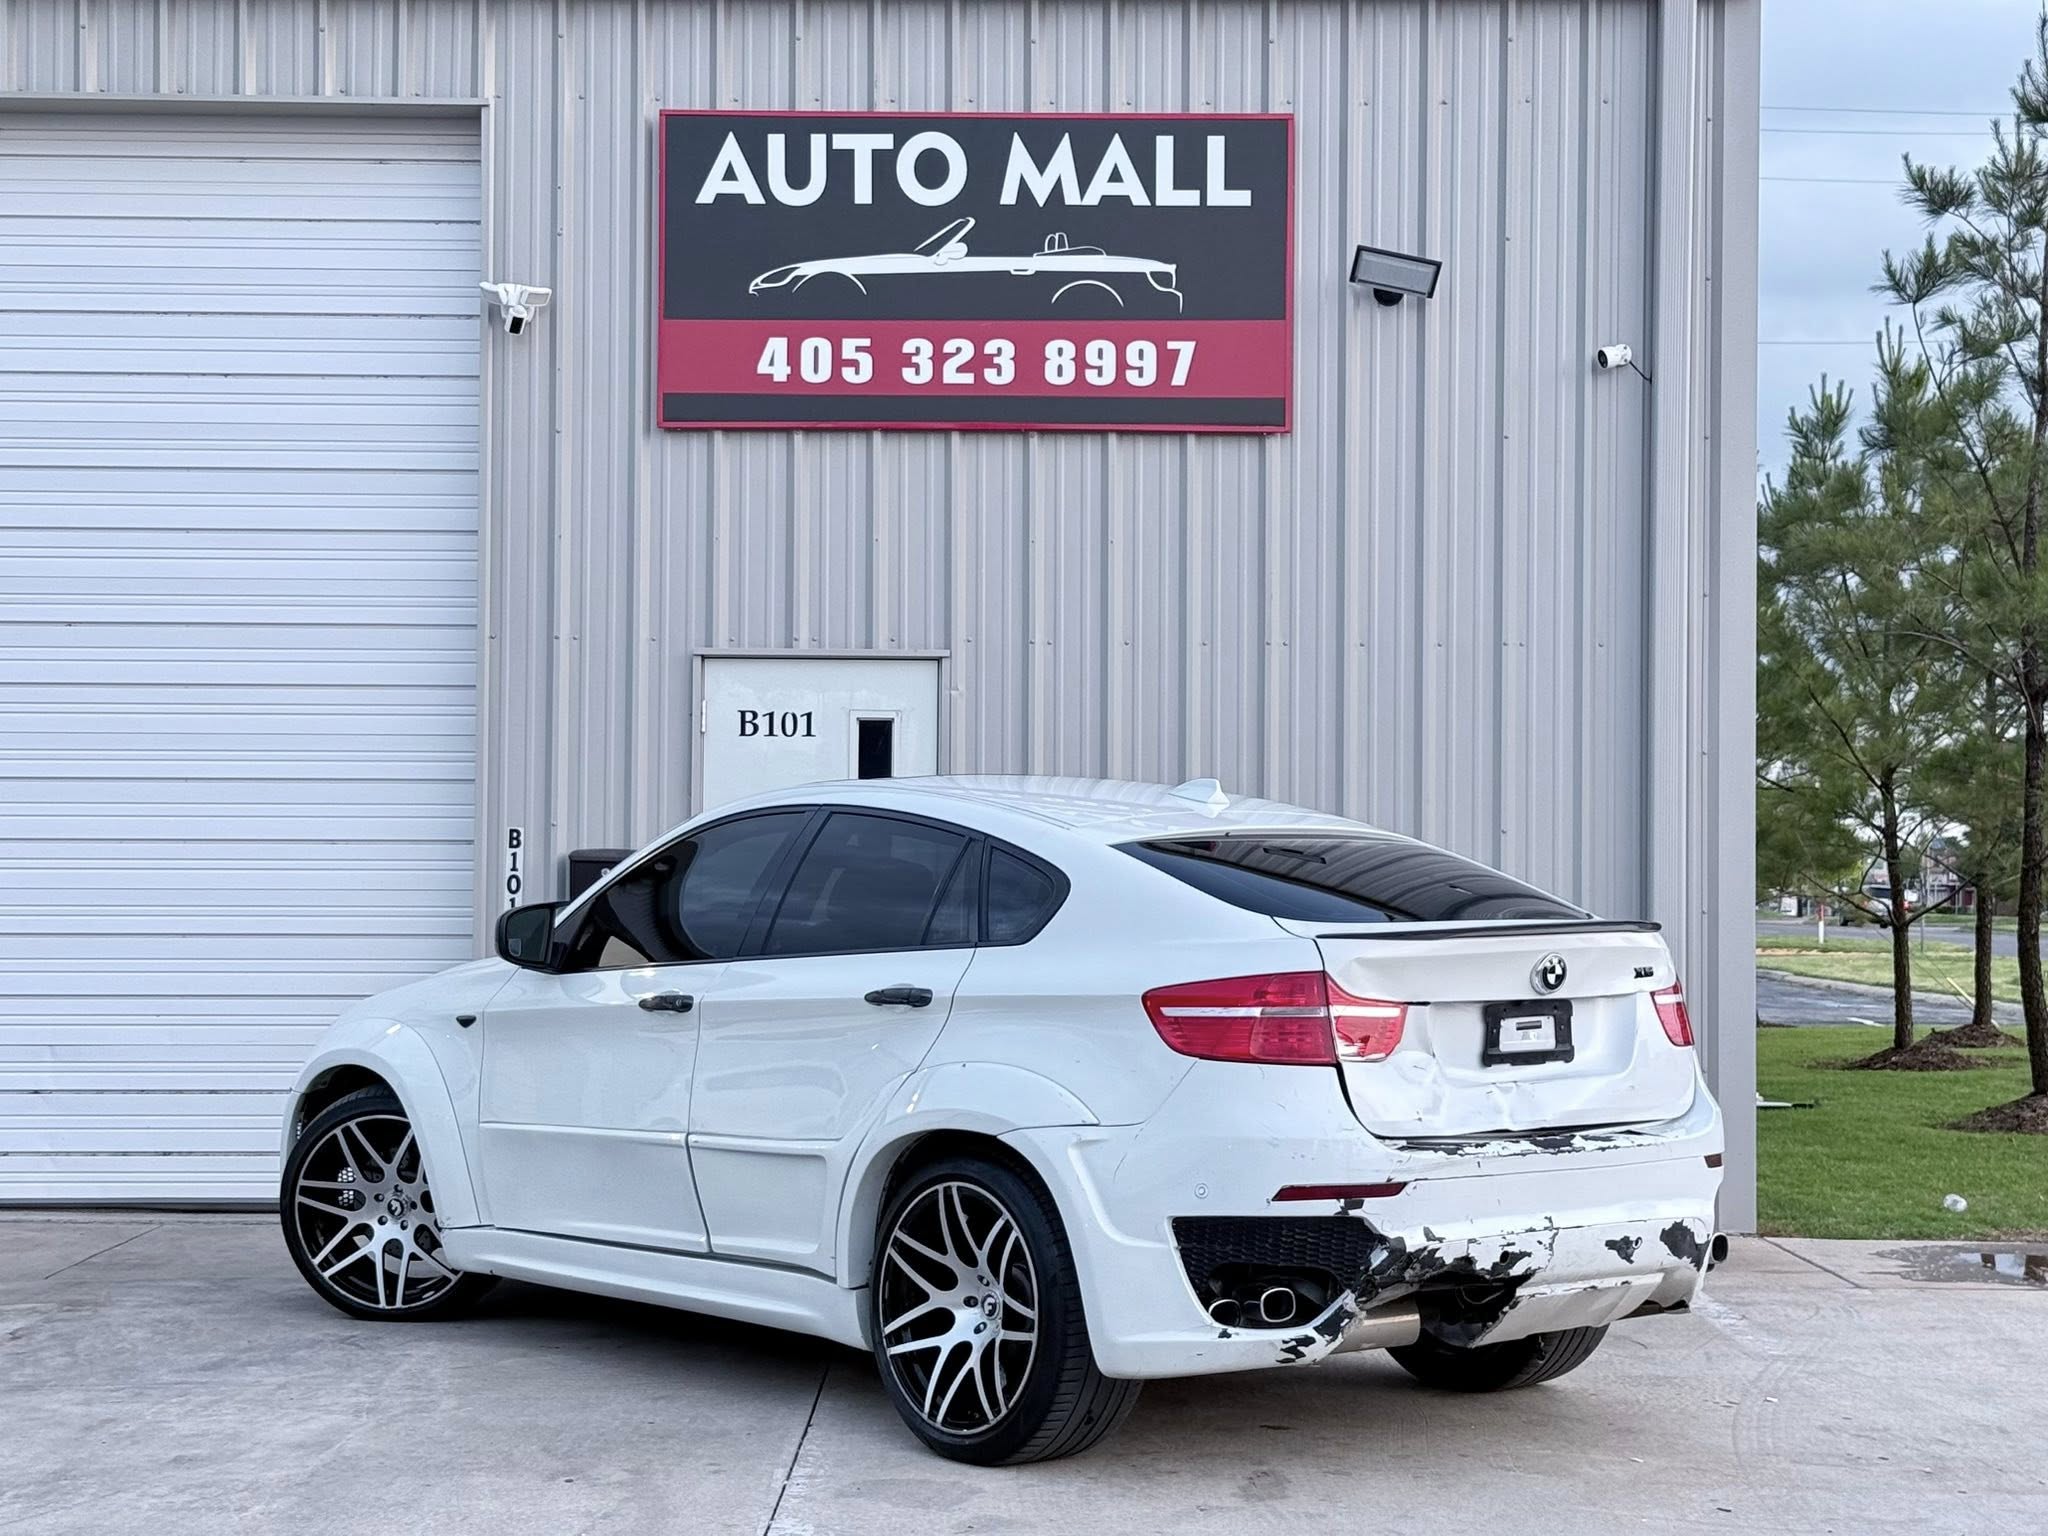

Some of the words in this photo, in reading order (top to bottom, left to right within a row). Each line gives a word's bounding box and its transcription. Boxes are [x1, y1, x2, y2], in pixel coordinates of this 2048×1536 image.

[695, 131, 968, 207] AUTO
[999, 131, 1252, 208] MALL
[756, 336, 873, 385] 405
[901, 337, 1016, 386] 323
[1043, 339, 1197, 388] 8997
[737, 709, 817, 738] B101
